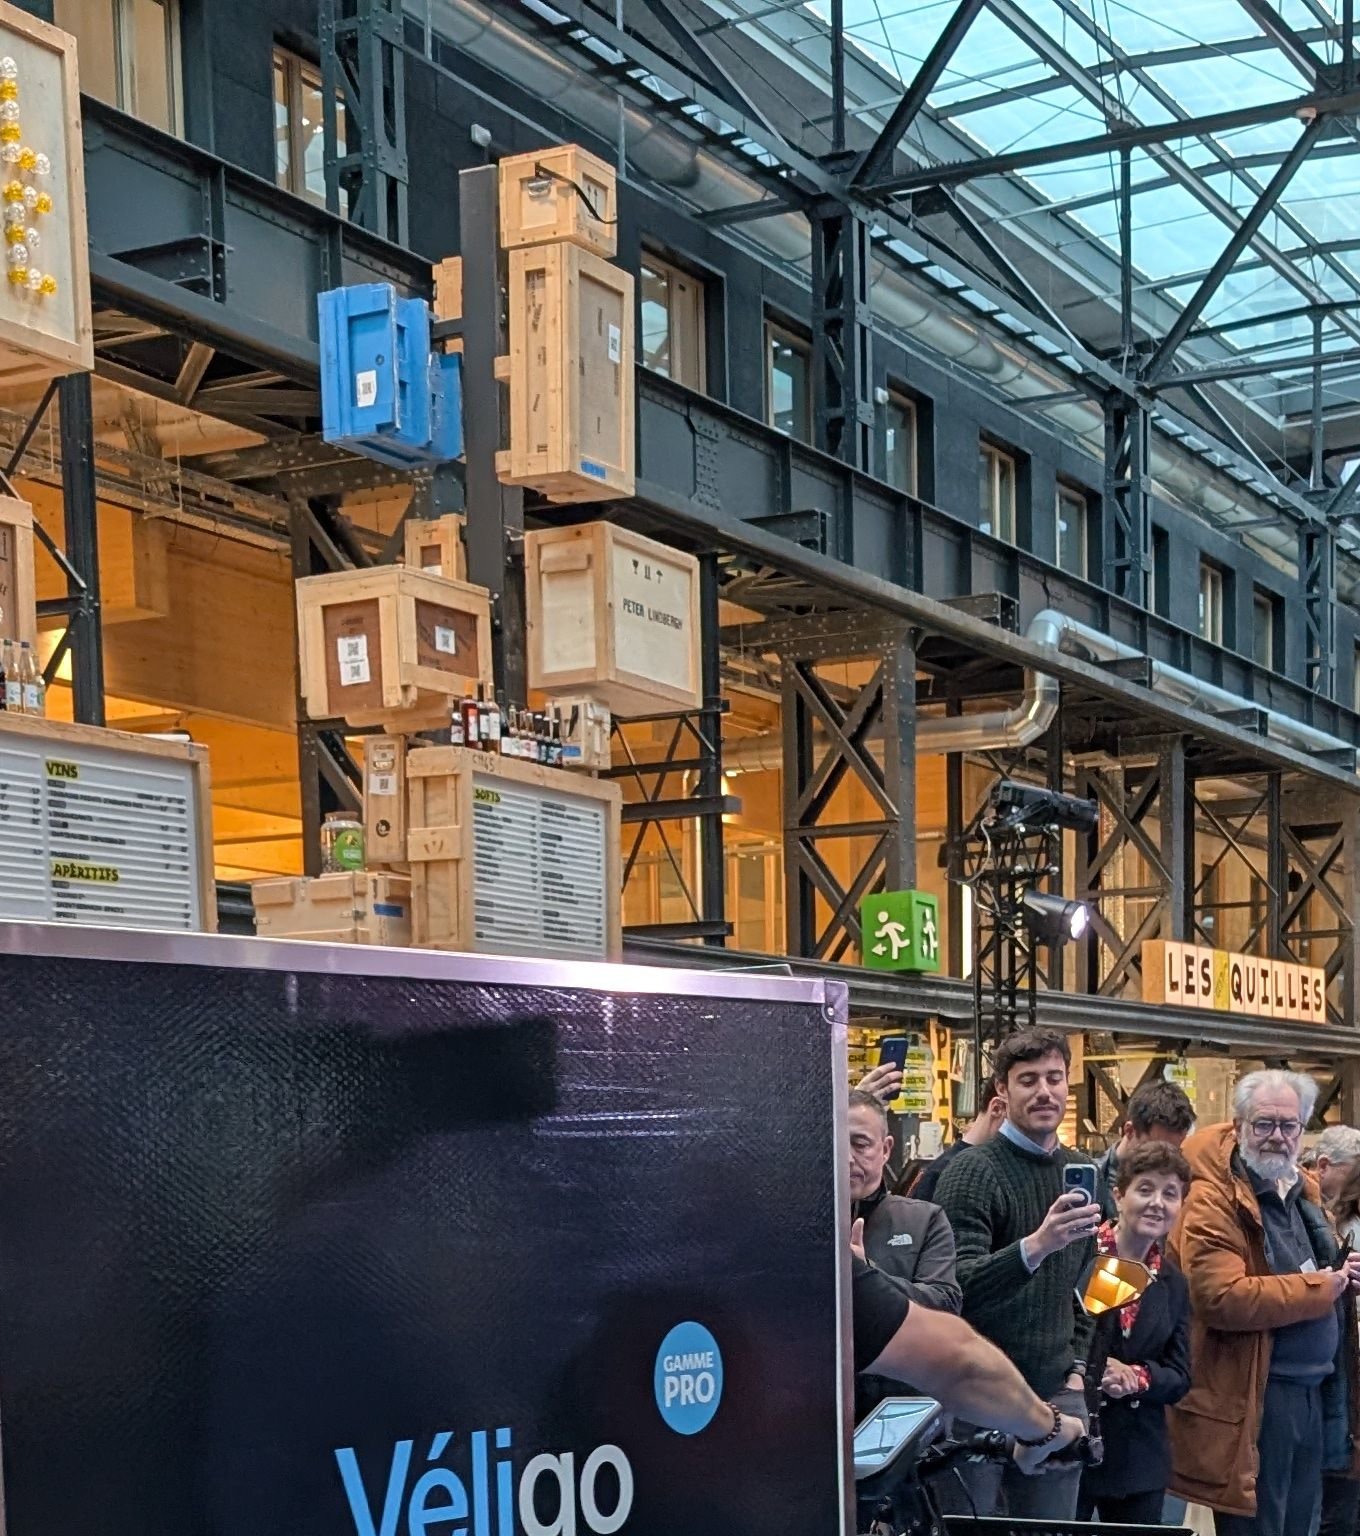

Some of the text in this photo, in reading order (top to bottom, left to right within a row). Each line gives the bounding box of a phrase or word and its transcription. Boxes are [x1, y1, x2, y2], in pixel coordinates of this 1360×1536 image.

[623, 598, 645, 618] PETER
[46, 760, 78, 779] VINS
[475, 788, 501, 803] SOFTS
[53, 863, 119, 882] APÉRITIFS
[1168, 951, 1323, 1012] LES QUILLES
[663, 1351, 714, 1374] GAMME
[663, 1373, 716, 1408] PRO
